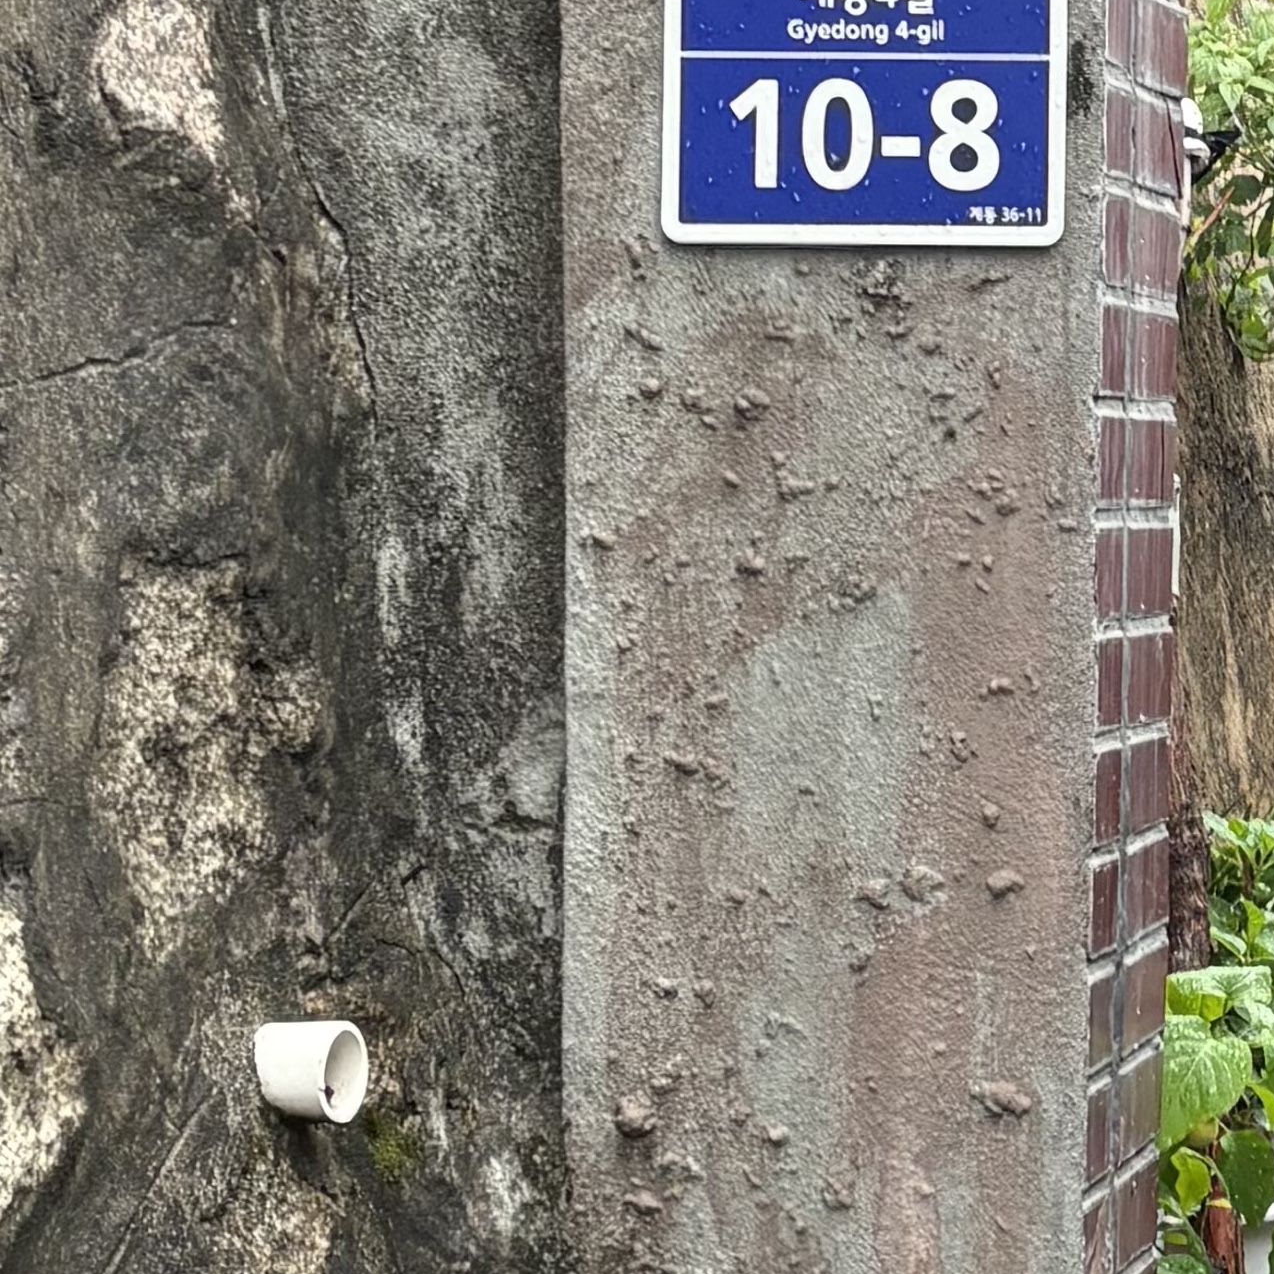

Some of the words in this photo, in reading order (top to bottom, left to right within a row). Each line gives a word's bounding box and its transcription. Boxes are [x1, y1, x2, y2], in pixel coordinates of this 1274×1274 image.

[787, 18, 889, 45] Gyedong
[895, 19, 945, 45] 4-gil
[728, 77, 1000, 191] 10-8
[1001, 206, 1041, 223] 36-11
